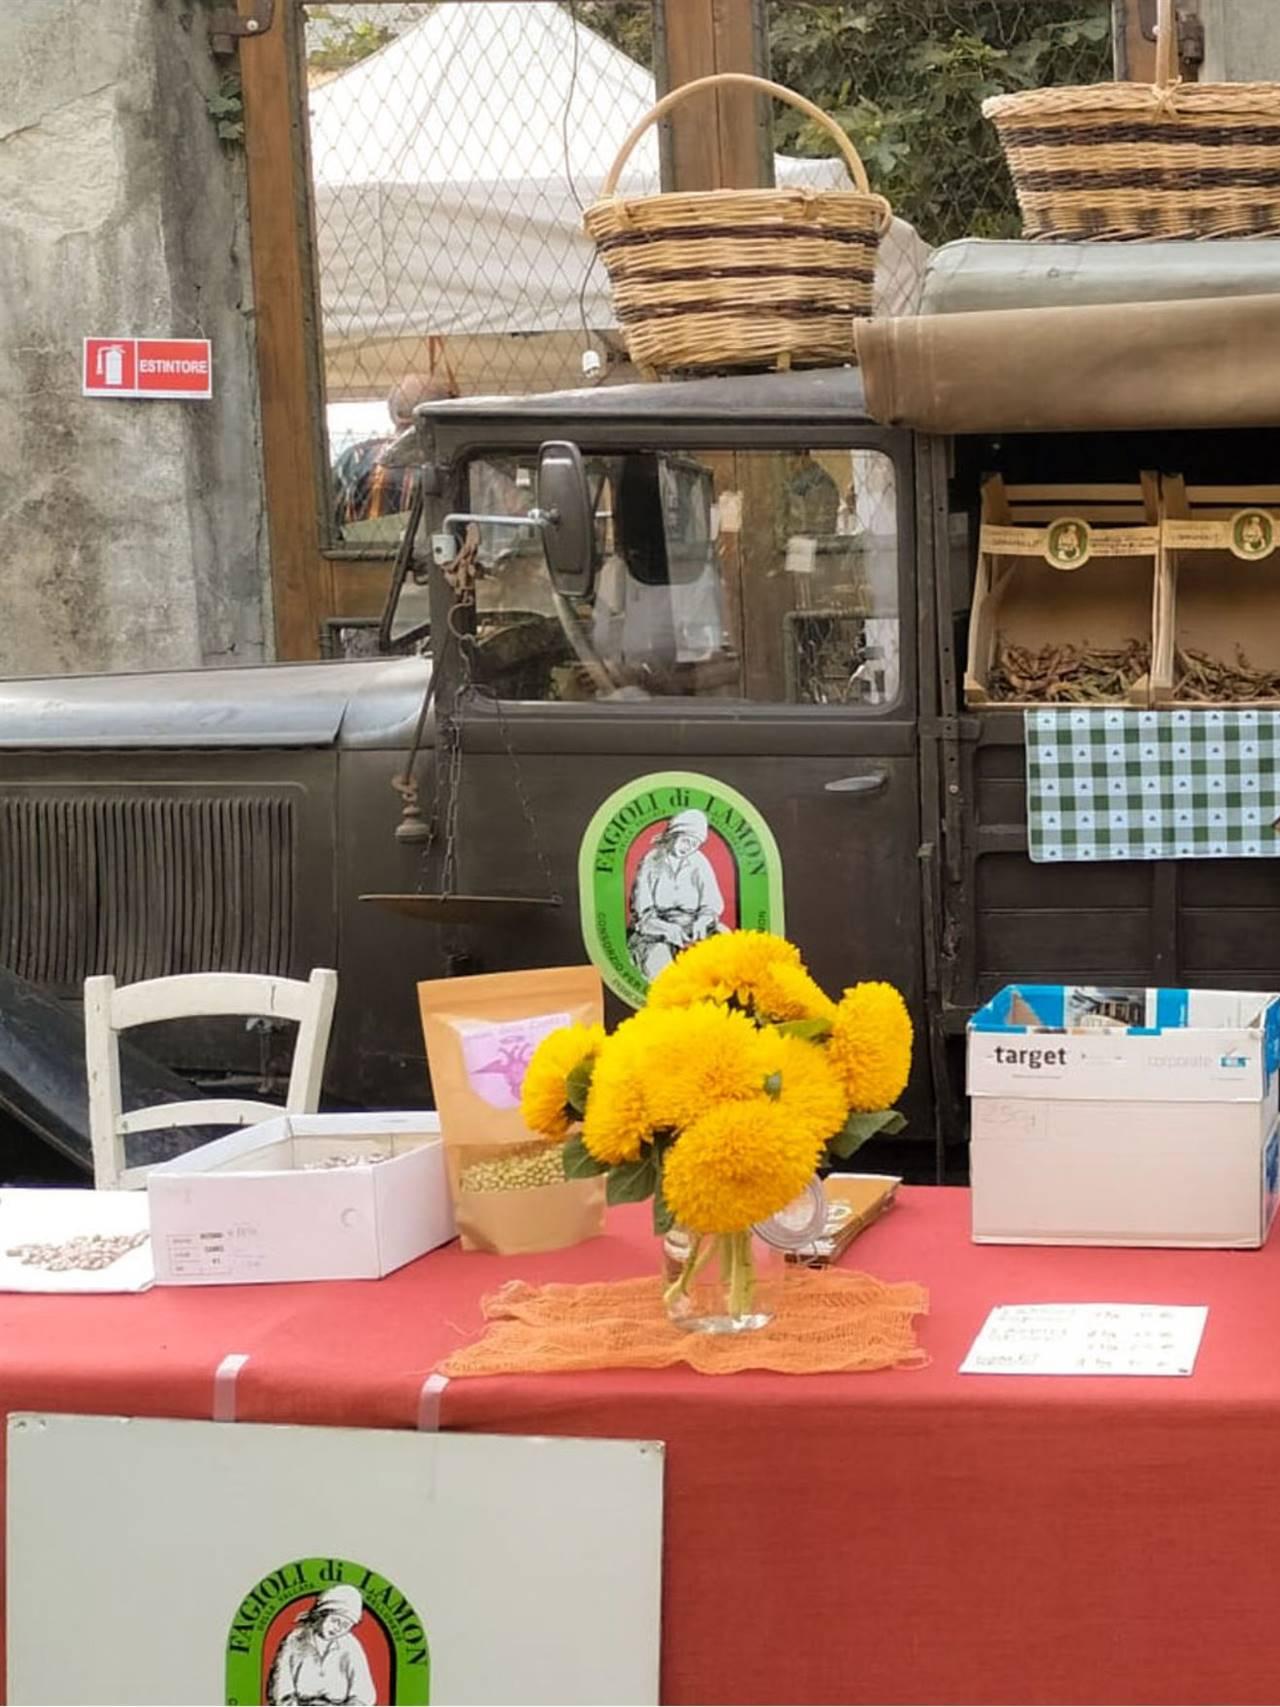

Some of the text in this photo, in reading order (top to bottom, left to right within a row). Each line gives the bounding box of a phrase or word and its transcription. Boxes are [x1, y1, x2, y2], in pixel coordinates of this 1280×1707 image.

[140, 359, 208, 374] ESTINTORE
[595, 793, 660, 874] FAGIOLI
[669, 787, 690, 808] di
[704, 795, 767, 876] LAMON
[994, 1045, 1067, 1069] target
[229, 1559, 428, 1666] FAGIOLI di LAMON
